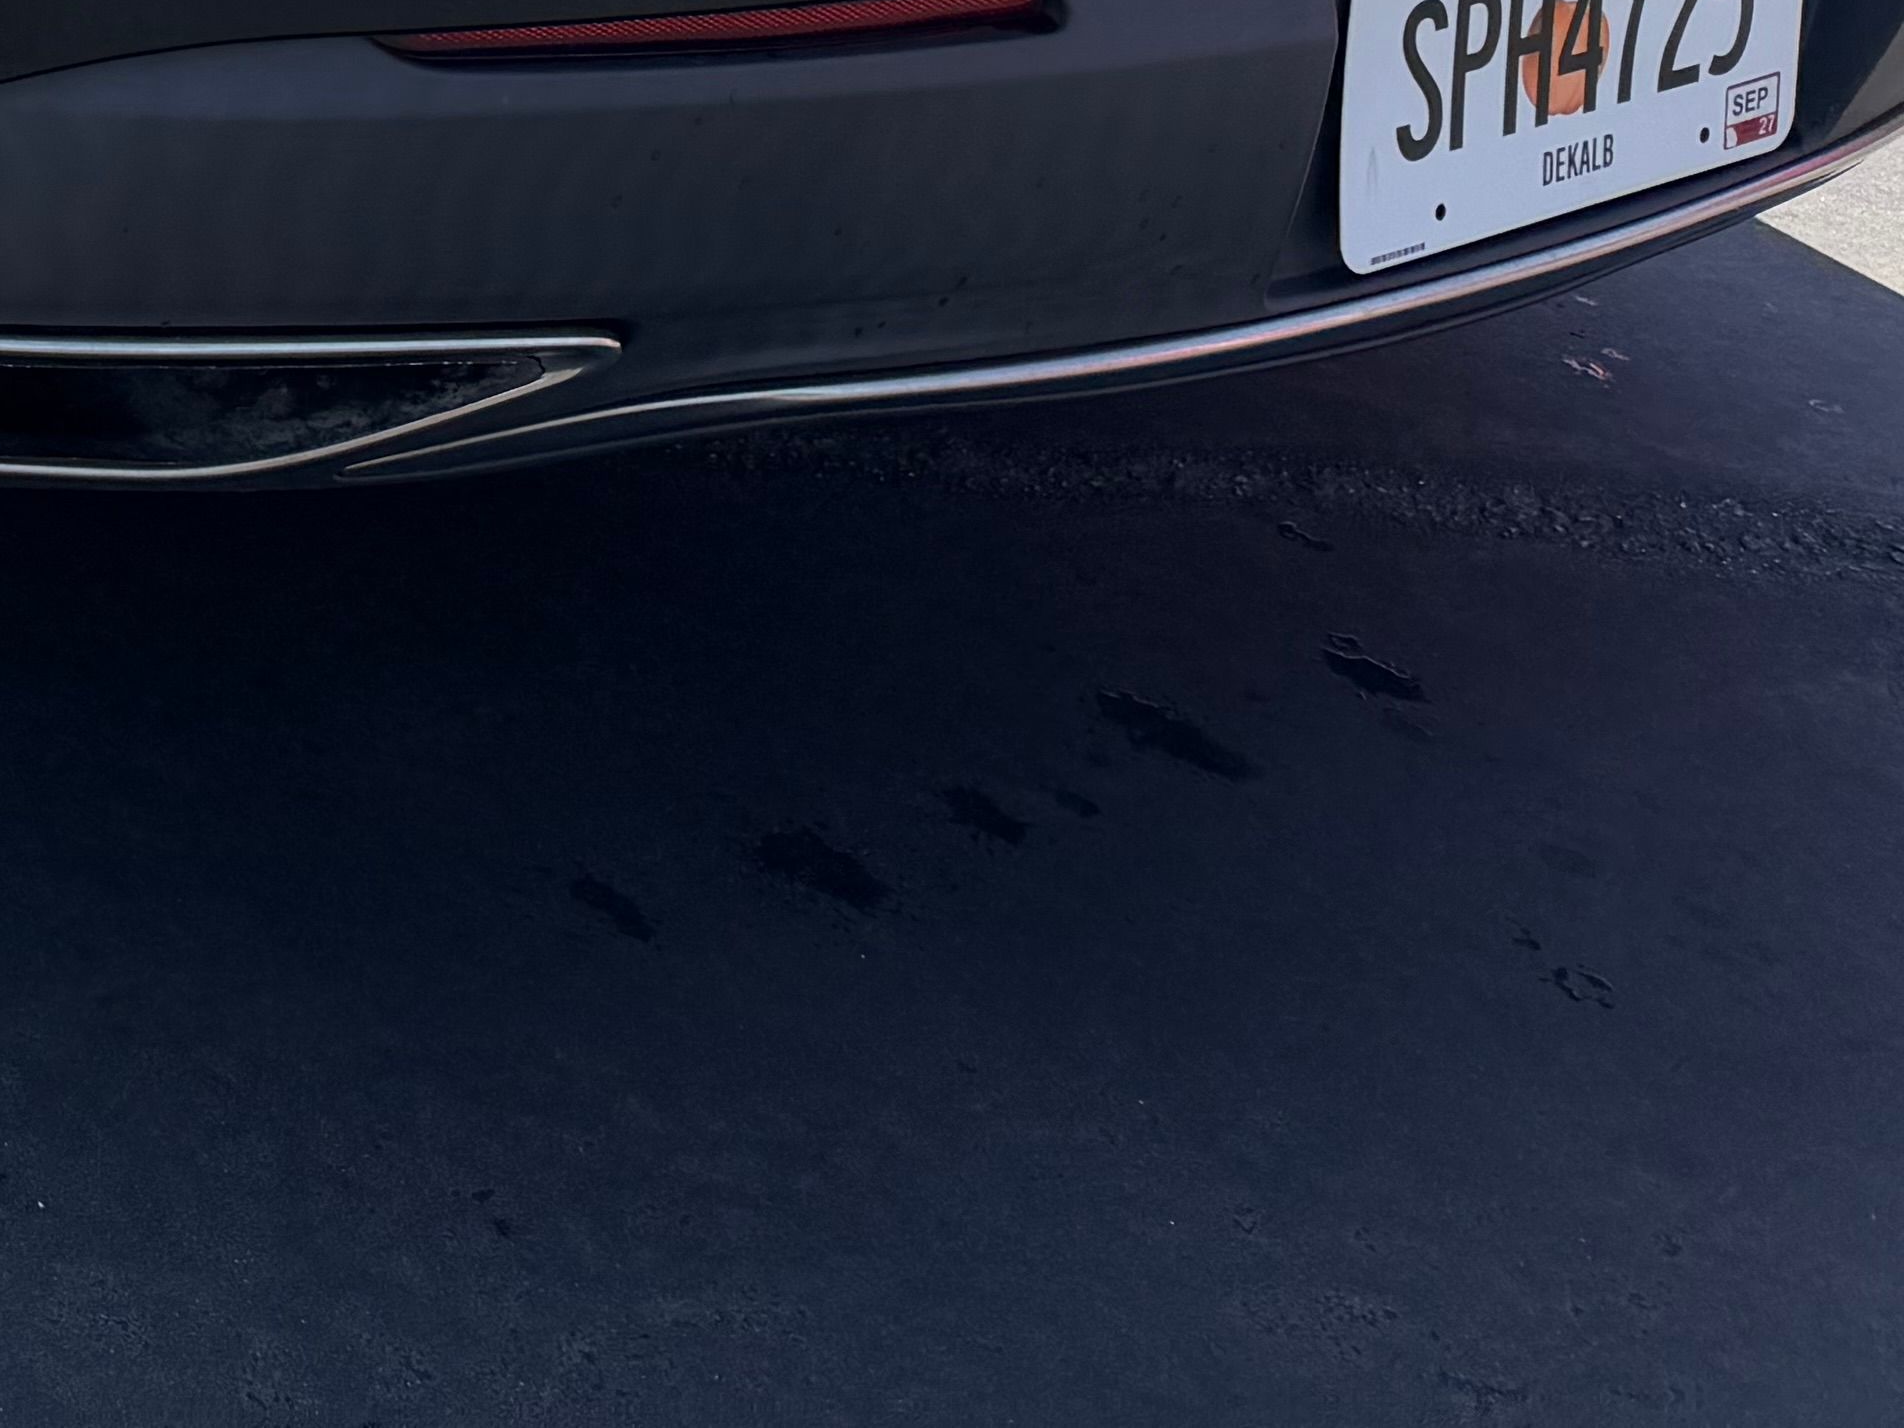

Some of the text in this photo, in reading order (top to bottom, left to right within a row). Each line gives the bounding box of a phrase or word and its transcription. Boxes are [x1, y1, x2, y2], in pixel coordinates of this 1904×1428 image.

[1732, 87, 1768, 116] SEP
[1759, 114, 1775, 135] 27
[1542, 134, 1614, 187] DEKALB
